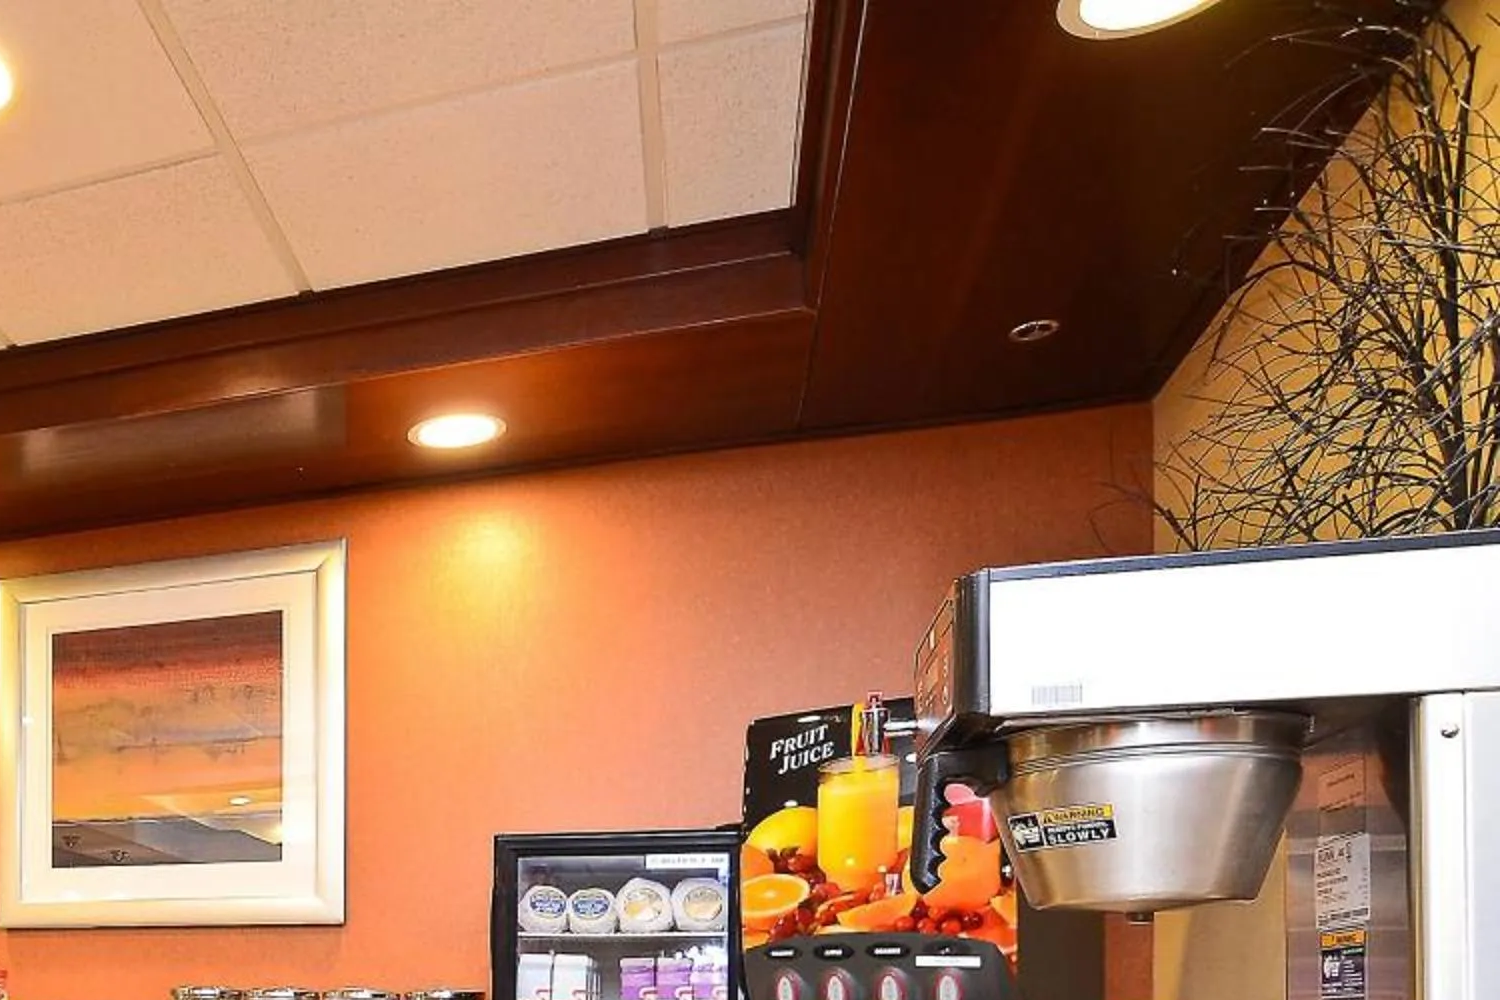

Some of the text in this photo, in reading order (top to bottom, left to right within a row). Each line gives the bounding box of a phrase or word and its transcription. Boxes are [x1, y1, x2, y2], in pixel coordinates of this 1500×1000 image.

[769, 723, 829, 760] FRUIT
[777, 741, 835, 775] JUICE
[1053, 807, 1105, 821] WARNING
[1048, 828, 1110, 844] SLOWLY
